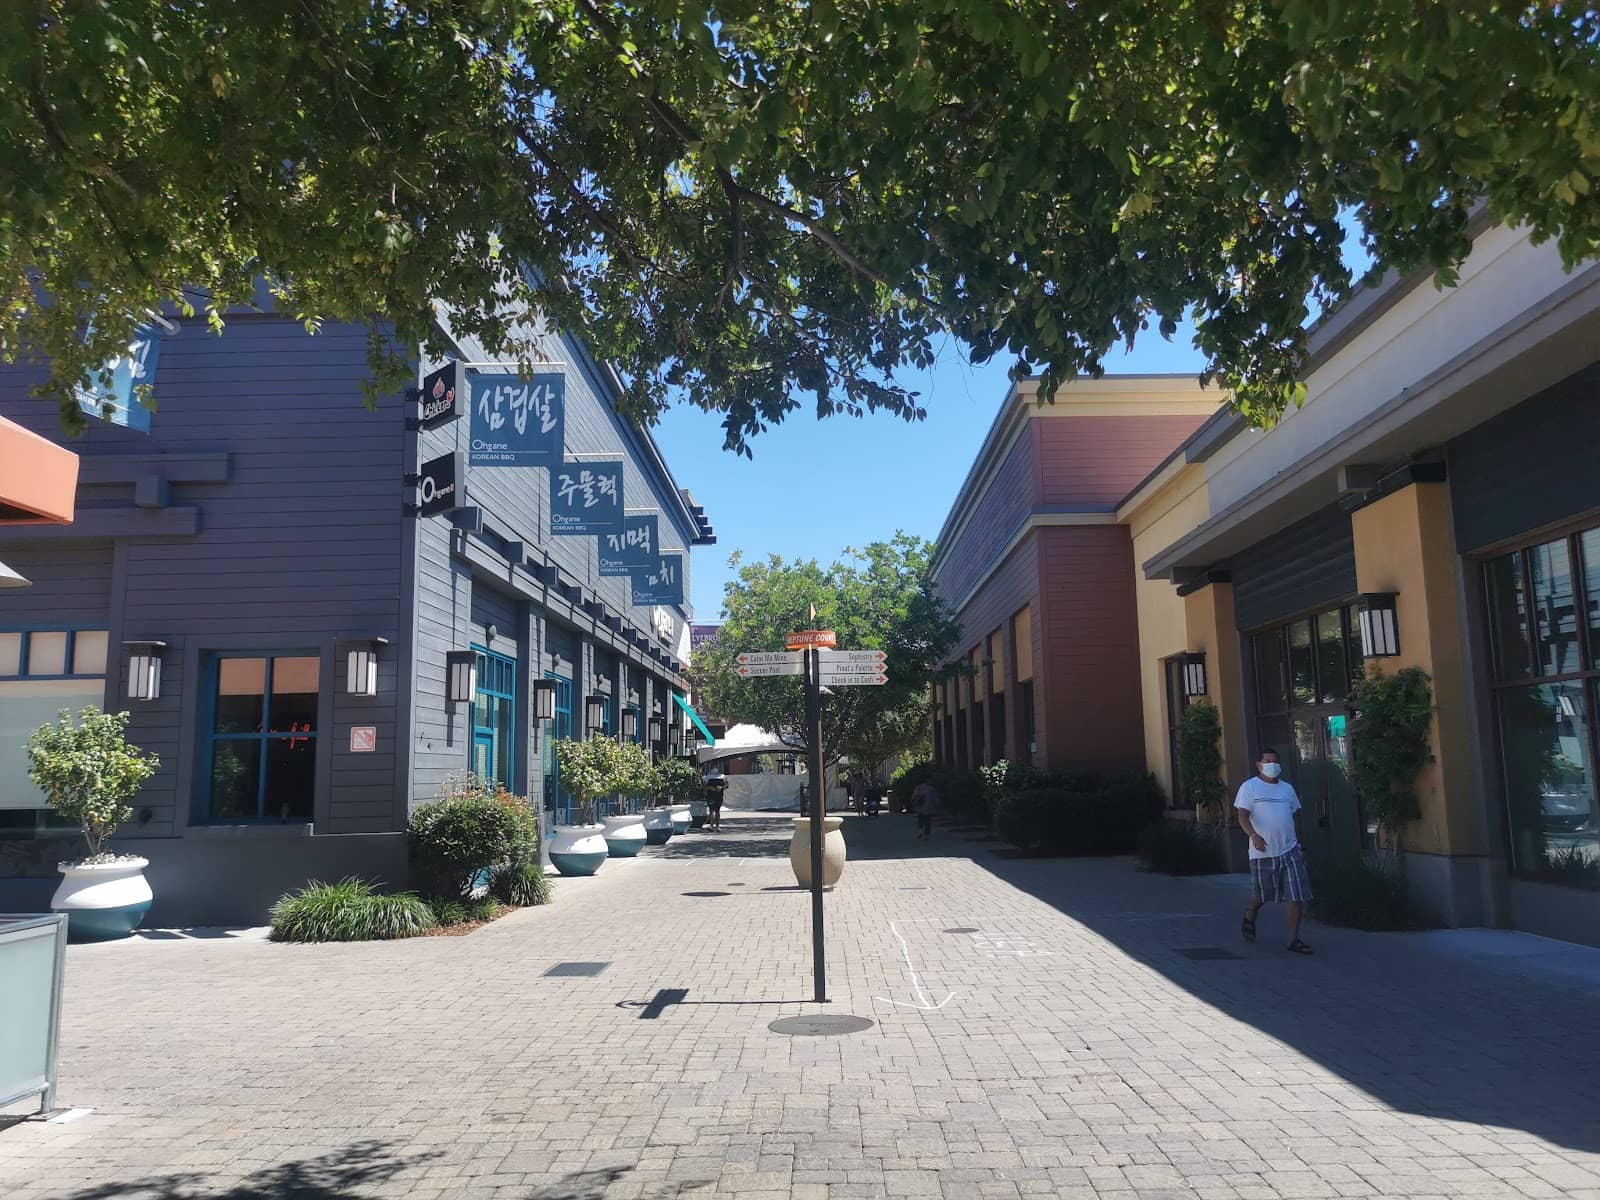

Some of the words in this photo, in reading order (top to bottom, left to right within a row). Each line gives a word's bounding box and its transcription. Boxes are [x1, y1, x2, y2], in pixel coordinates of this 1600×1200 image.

[478, 384, 557, 435] 삼겹살
[472, 439, 508, 452] Ohgane
[557, 470, 617, 508] 주물럭
[552, 514, 581, 524] Ohgane
[848, 653, 873, 663] Sophistry
